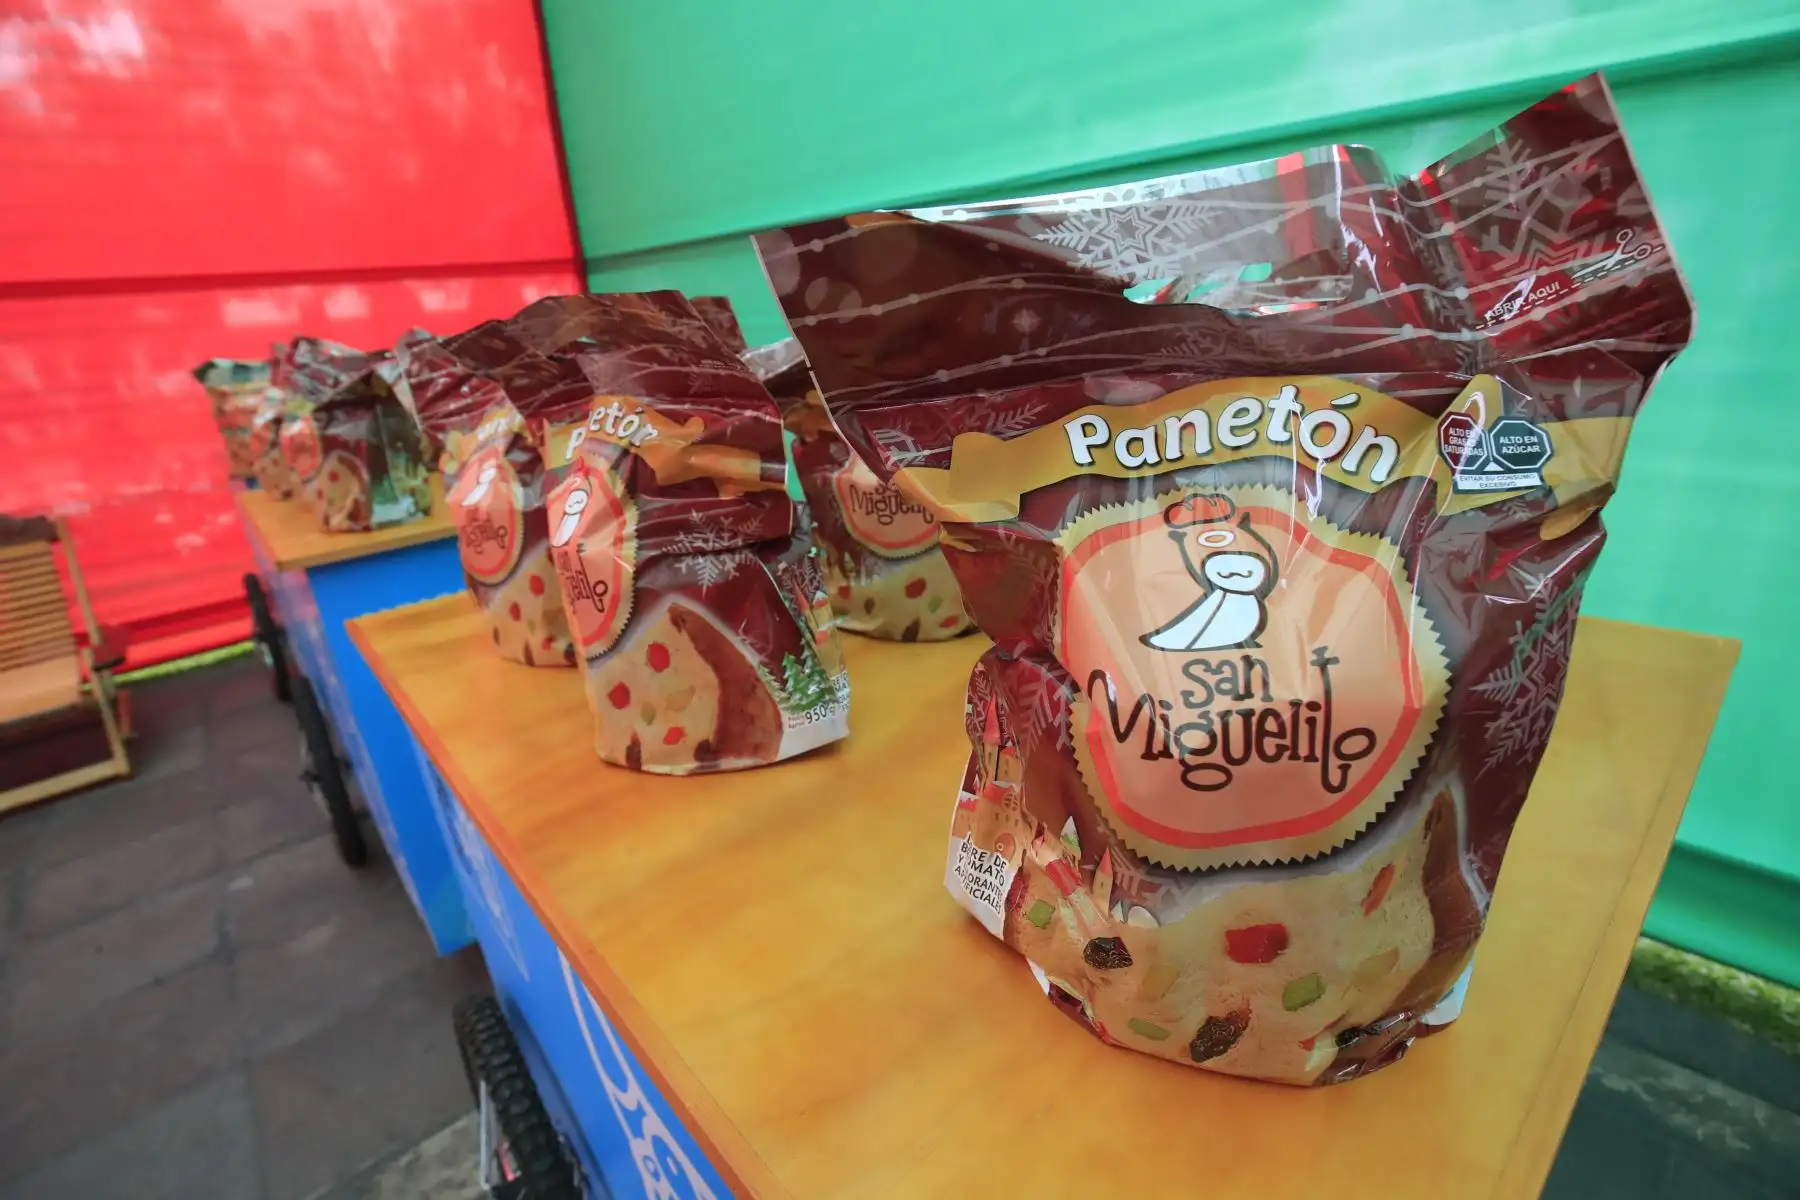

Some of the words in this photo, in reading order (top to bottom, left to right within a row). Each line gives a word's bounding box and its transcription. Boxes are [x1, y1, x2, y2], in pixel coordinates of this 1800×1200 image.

[1528, 282, 1560, 302] AQUI
[1064, 383, 1401, 484] Panetón
[1448, 427, 1465, 437] ALTO
[1499, 436, 1523, 444] ALTO
[1523, 435, 1538, 443] EN
[1448, 436, 1476, 447] GRAS
[1501, 444, 1541, 454] AZÚCAR
[1087, 646, 1377, 794] Miguelito
[961, 842, 1005, 886] BMATO
